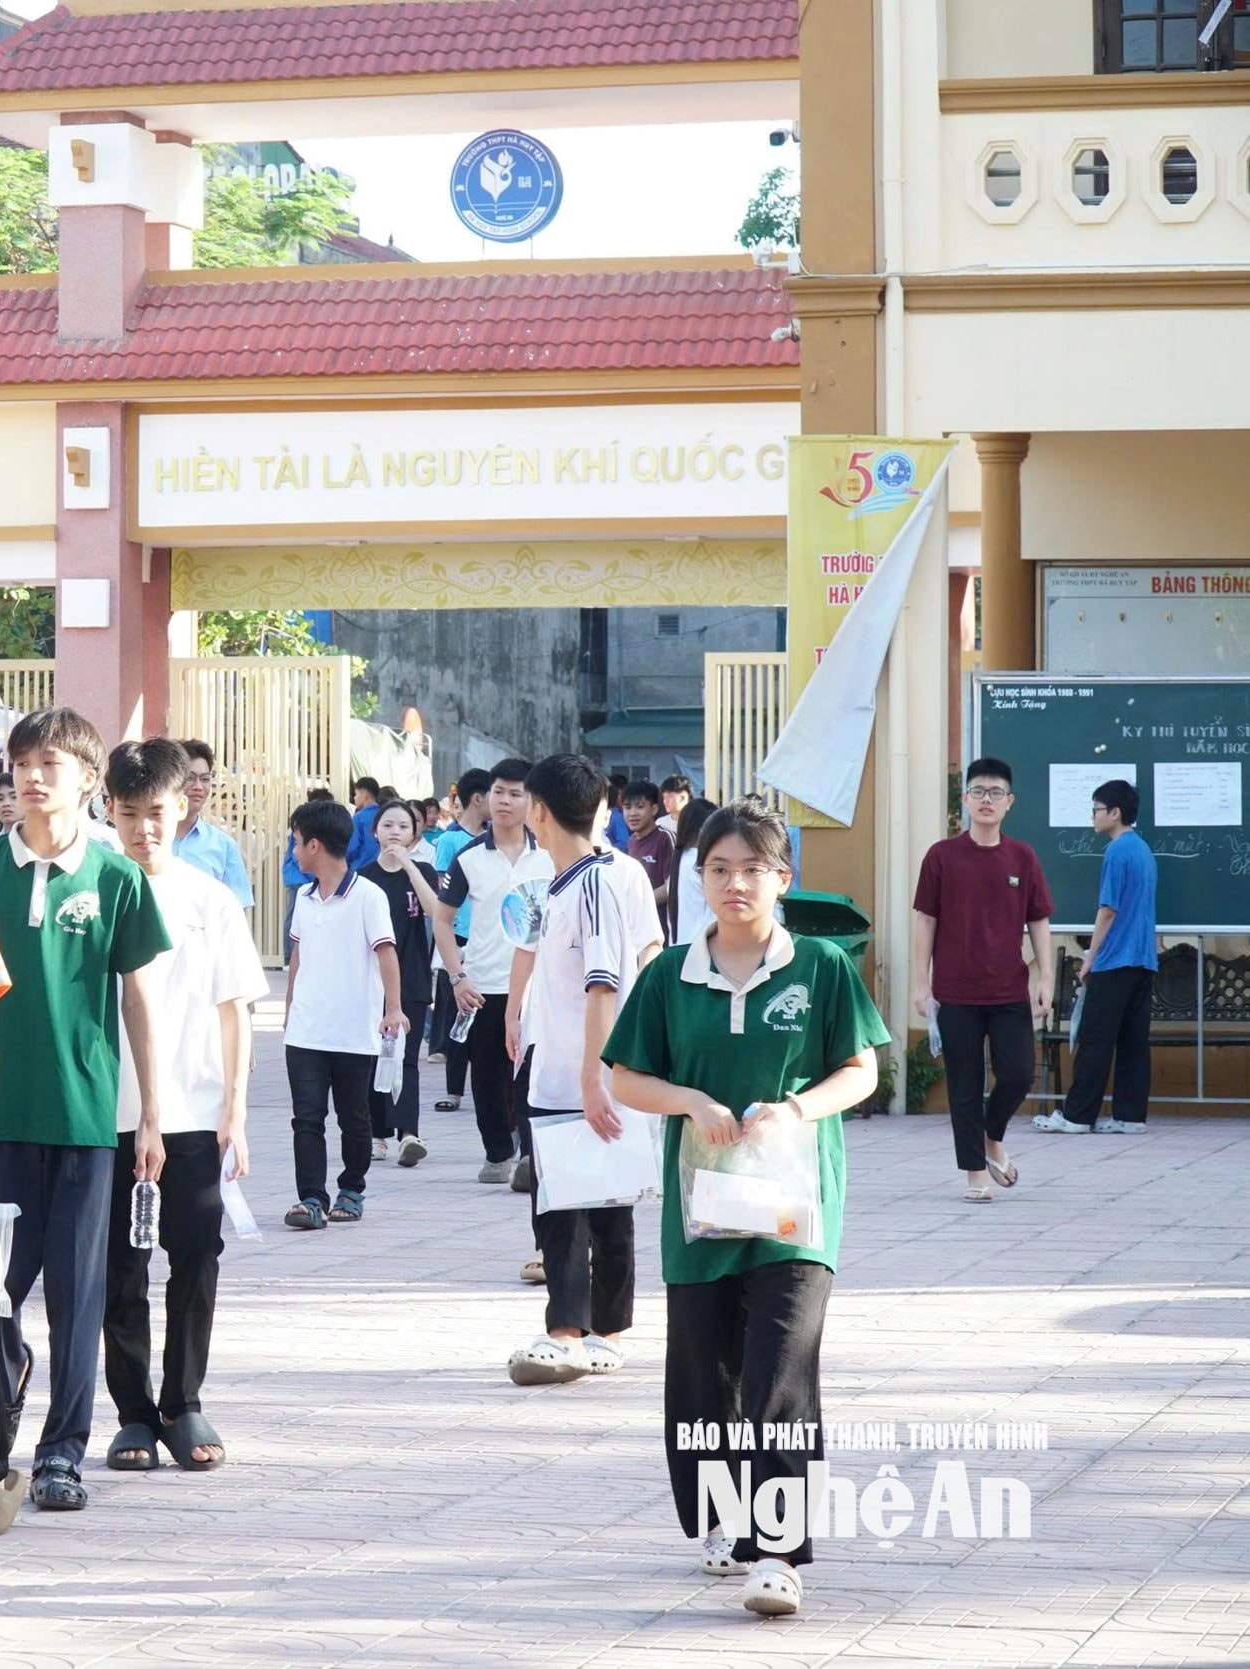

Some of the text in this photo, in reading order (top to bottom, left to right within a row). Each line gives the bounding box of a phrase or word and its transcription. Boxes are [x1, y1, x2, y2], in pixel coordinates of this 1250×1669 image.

[154, 445, 240, 493] HIỀN
[253, 443, 309, 490] TÀI
[321, 442, 367, 488] LÀ
[381, 442, 541, 487] NGUYÊN
[553, 440, 618, 484] KHÍ
[629, 431, 746, 486] QUỐC
[829, 583, 850, 604] HÀ
[1151, 570, 1196, 594] BẢNG
